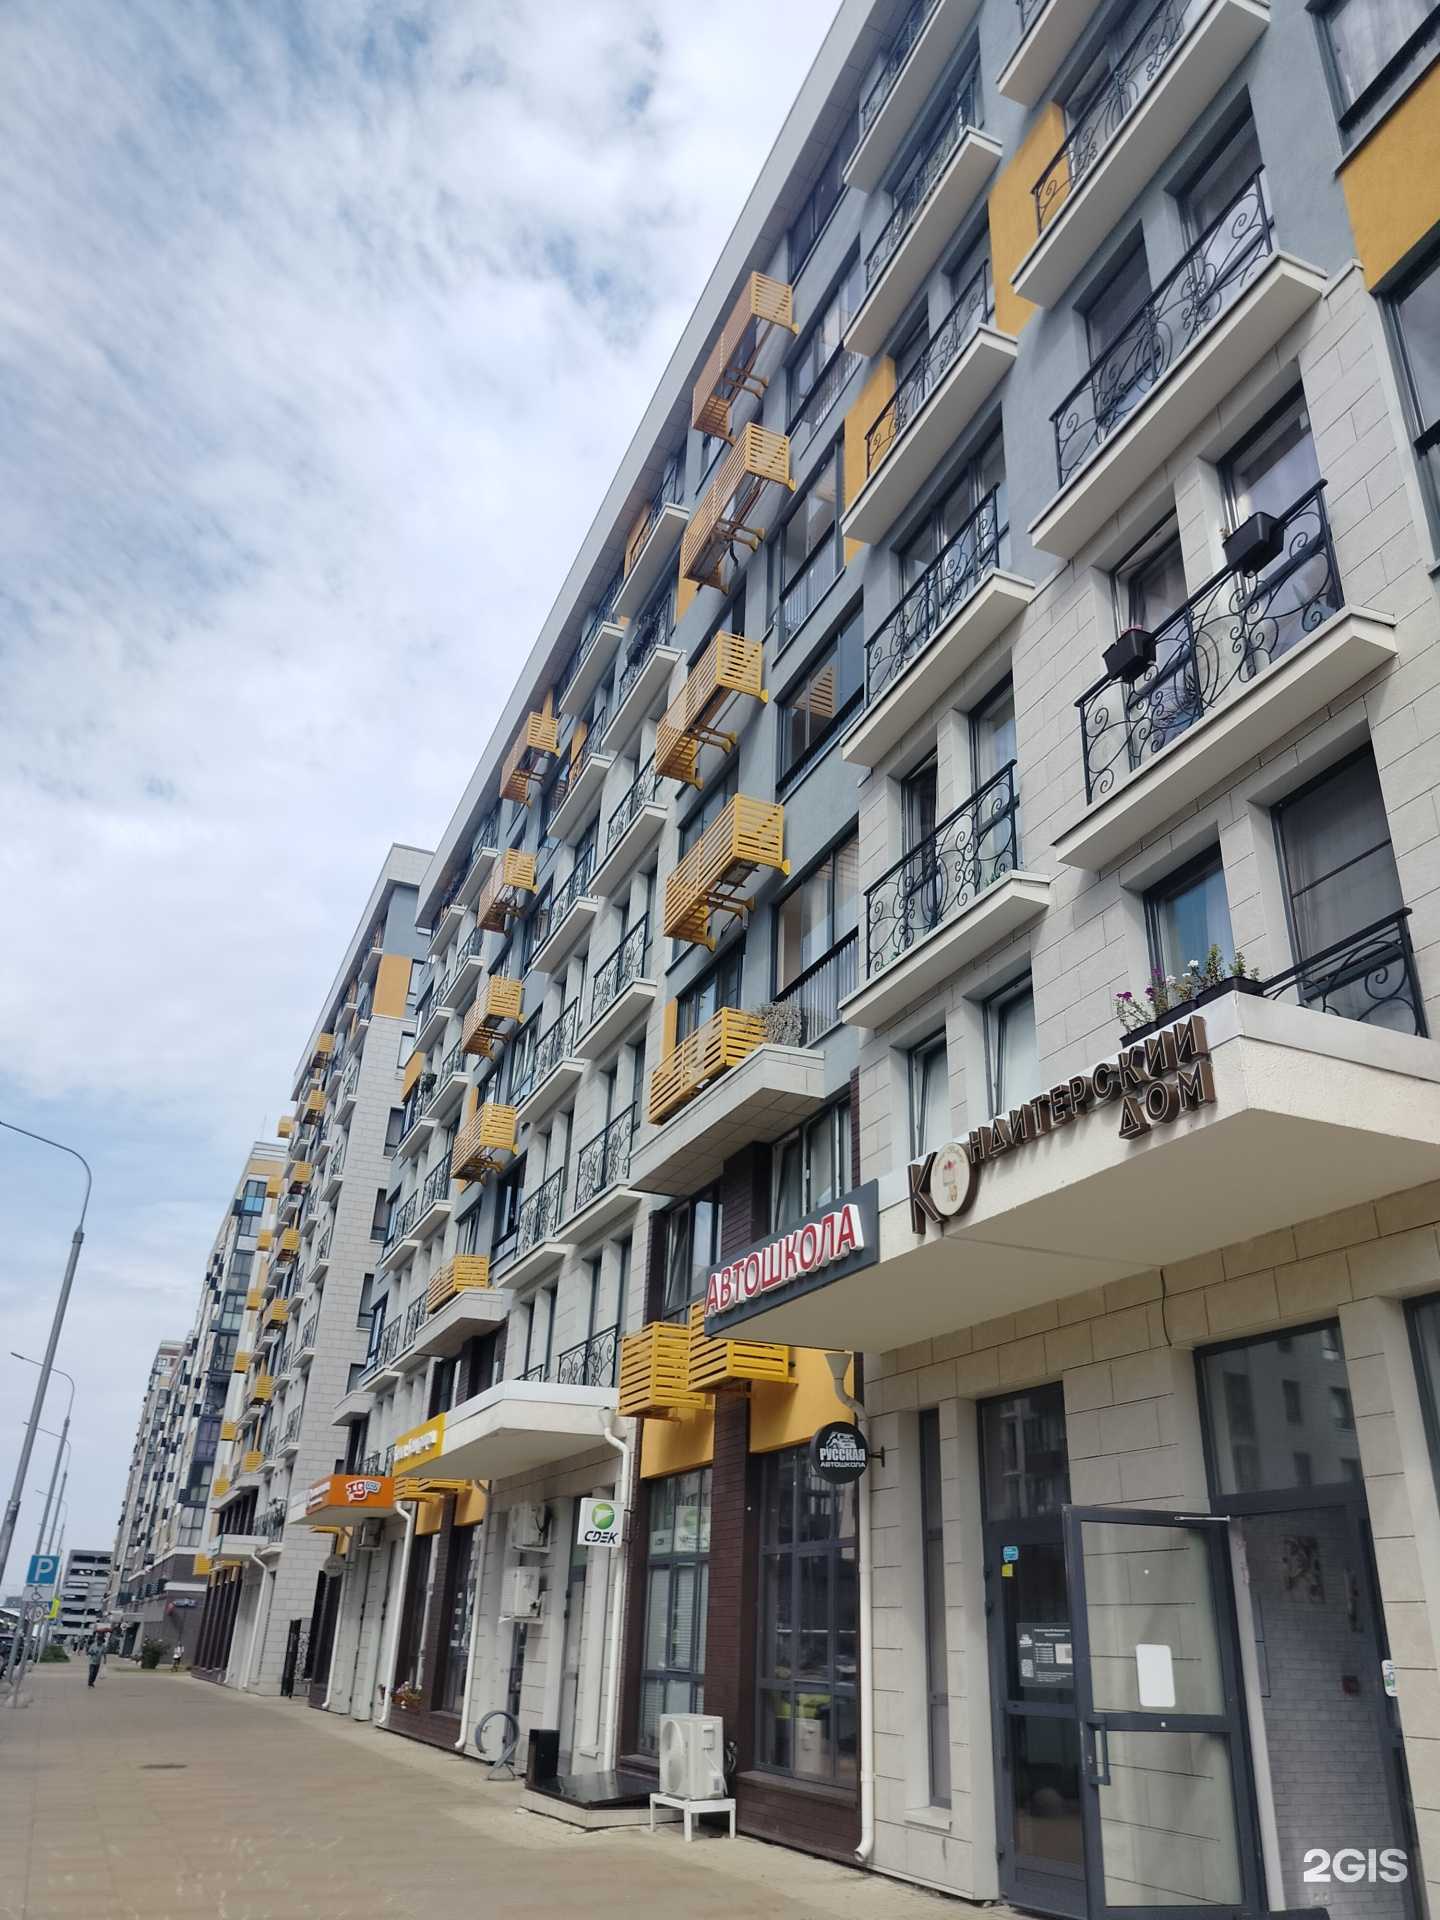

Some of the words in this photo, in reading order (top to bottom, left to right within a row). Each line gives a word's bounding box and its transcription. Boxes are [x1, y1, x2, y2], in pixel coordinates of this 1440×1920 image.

[1119, 1060, 1215, 1139] ДОМ
[704, 1203, 864, 1317] АВТОШКОЛА
[820, 1447, 865, 1461] РУССКАЯ
[584, 1530, 618, 1544] CDEK
[34, 1558, 53, 1582] P
